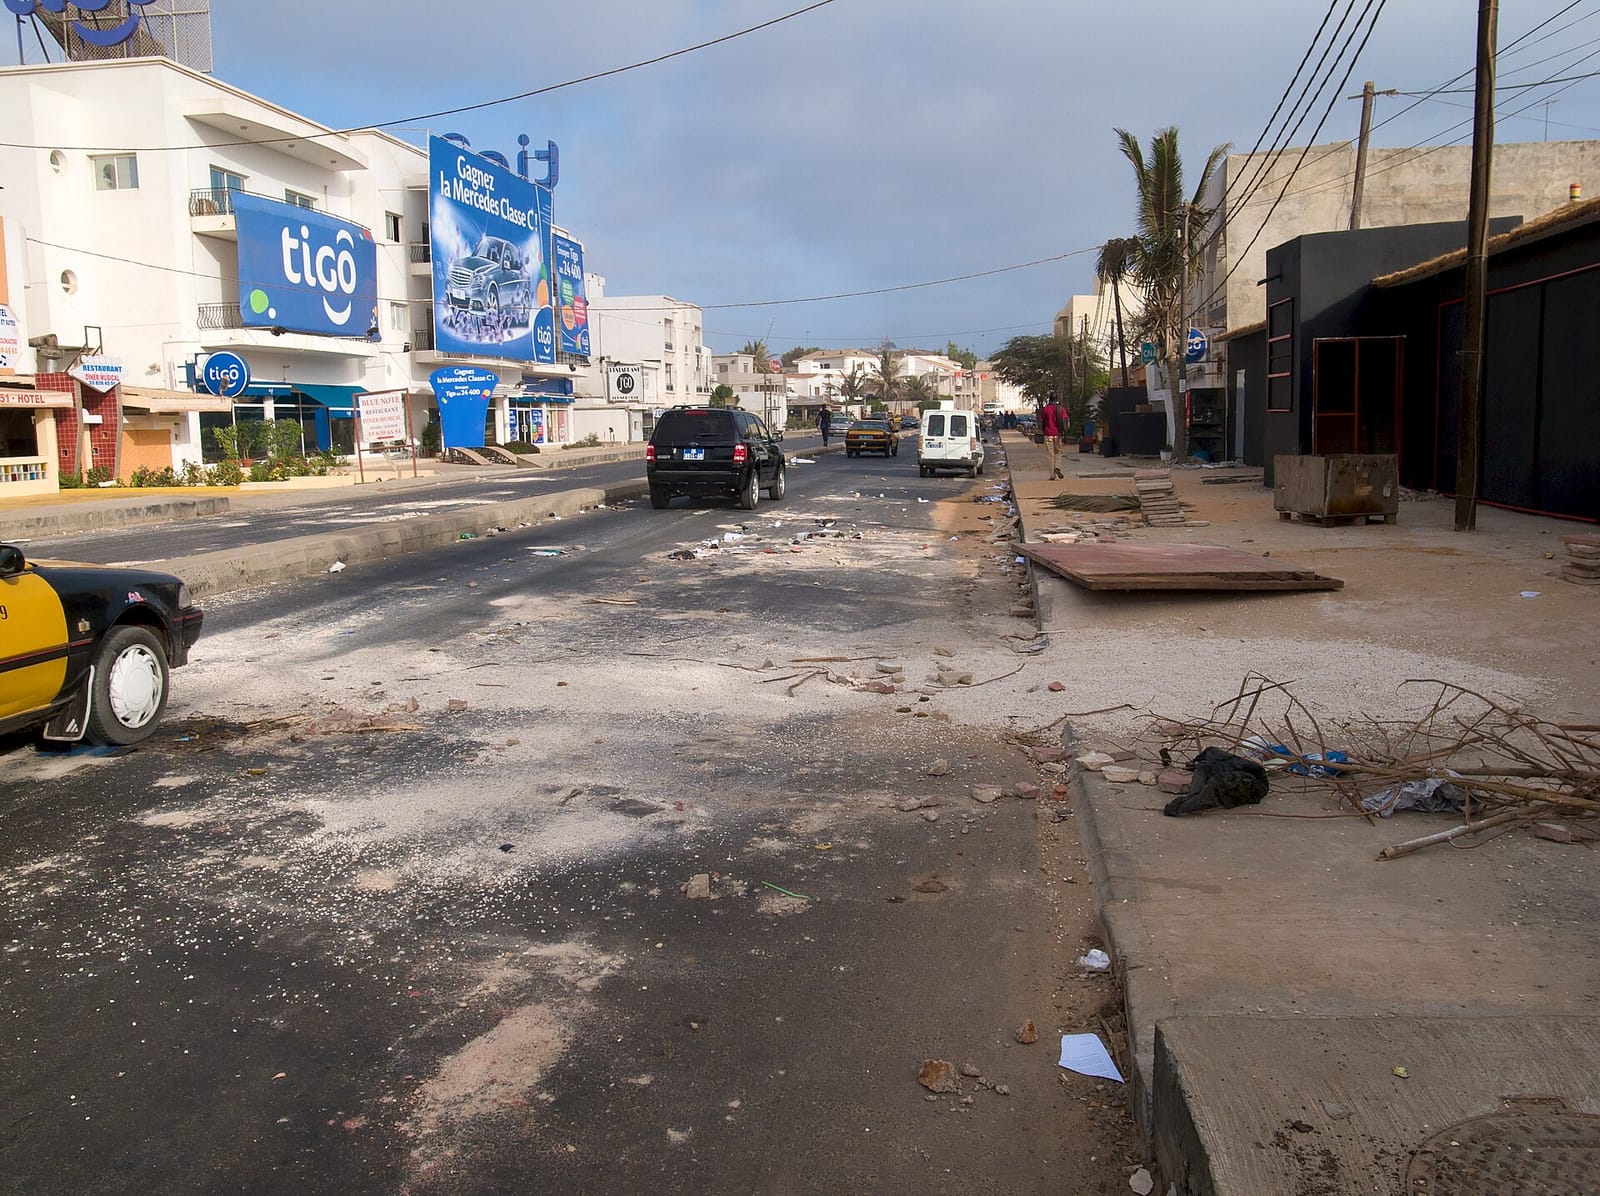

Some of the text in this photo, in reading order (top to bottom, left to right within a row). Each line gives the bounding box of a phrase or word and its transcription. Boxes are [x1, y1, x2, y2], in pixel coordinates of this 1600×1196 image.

[457, 154, 495, 192] Gagnez
[440, 170, 451, 198] la
[453, 177, 499, 216] Mercedes
[500, 197, 526, 228] Classe
[281, 224, 357, 295] tigo
[82, 364, 122, 373] RESTAURANT
[17, 394, 46, 404] HOTEL
[361, 396, 400, 407] BLUE NOTE
